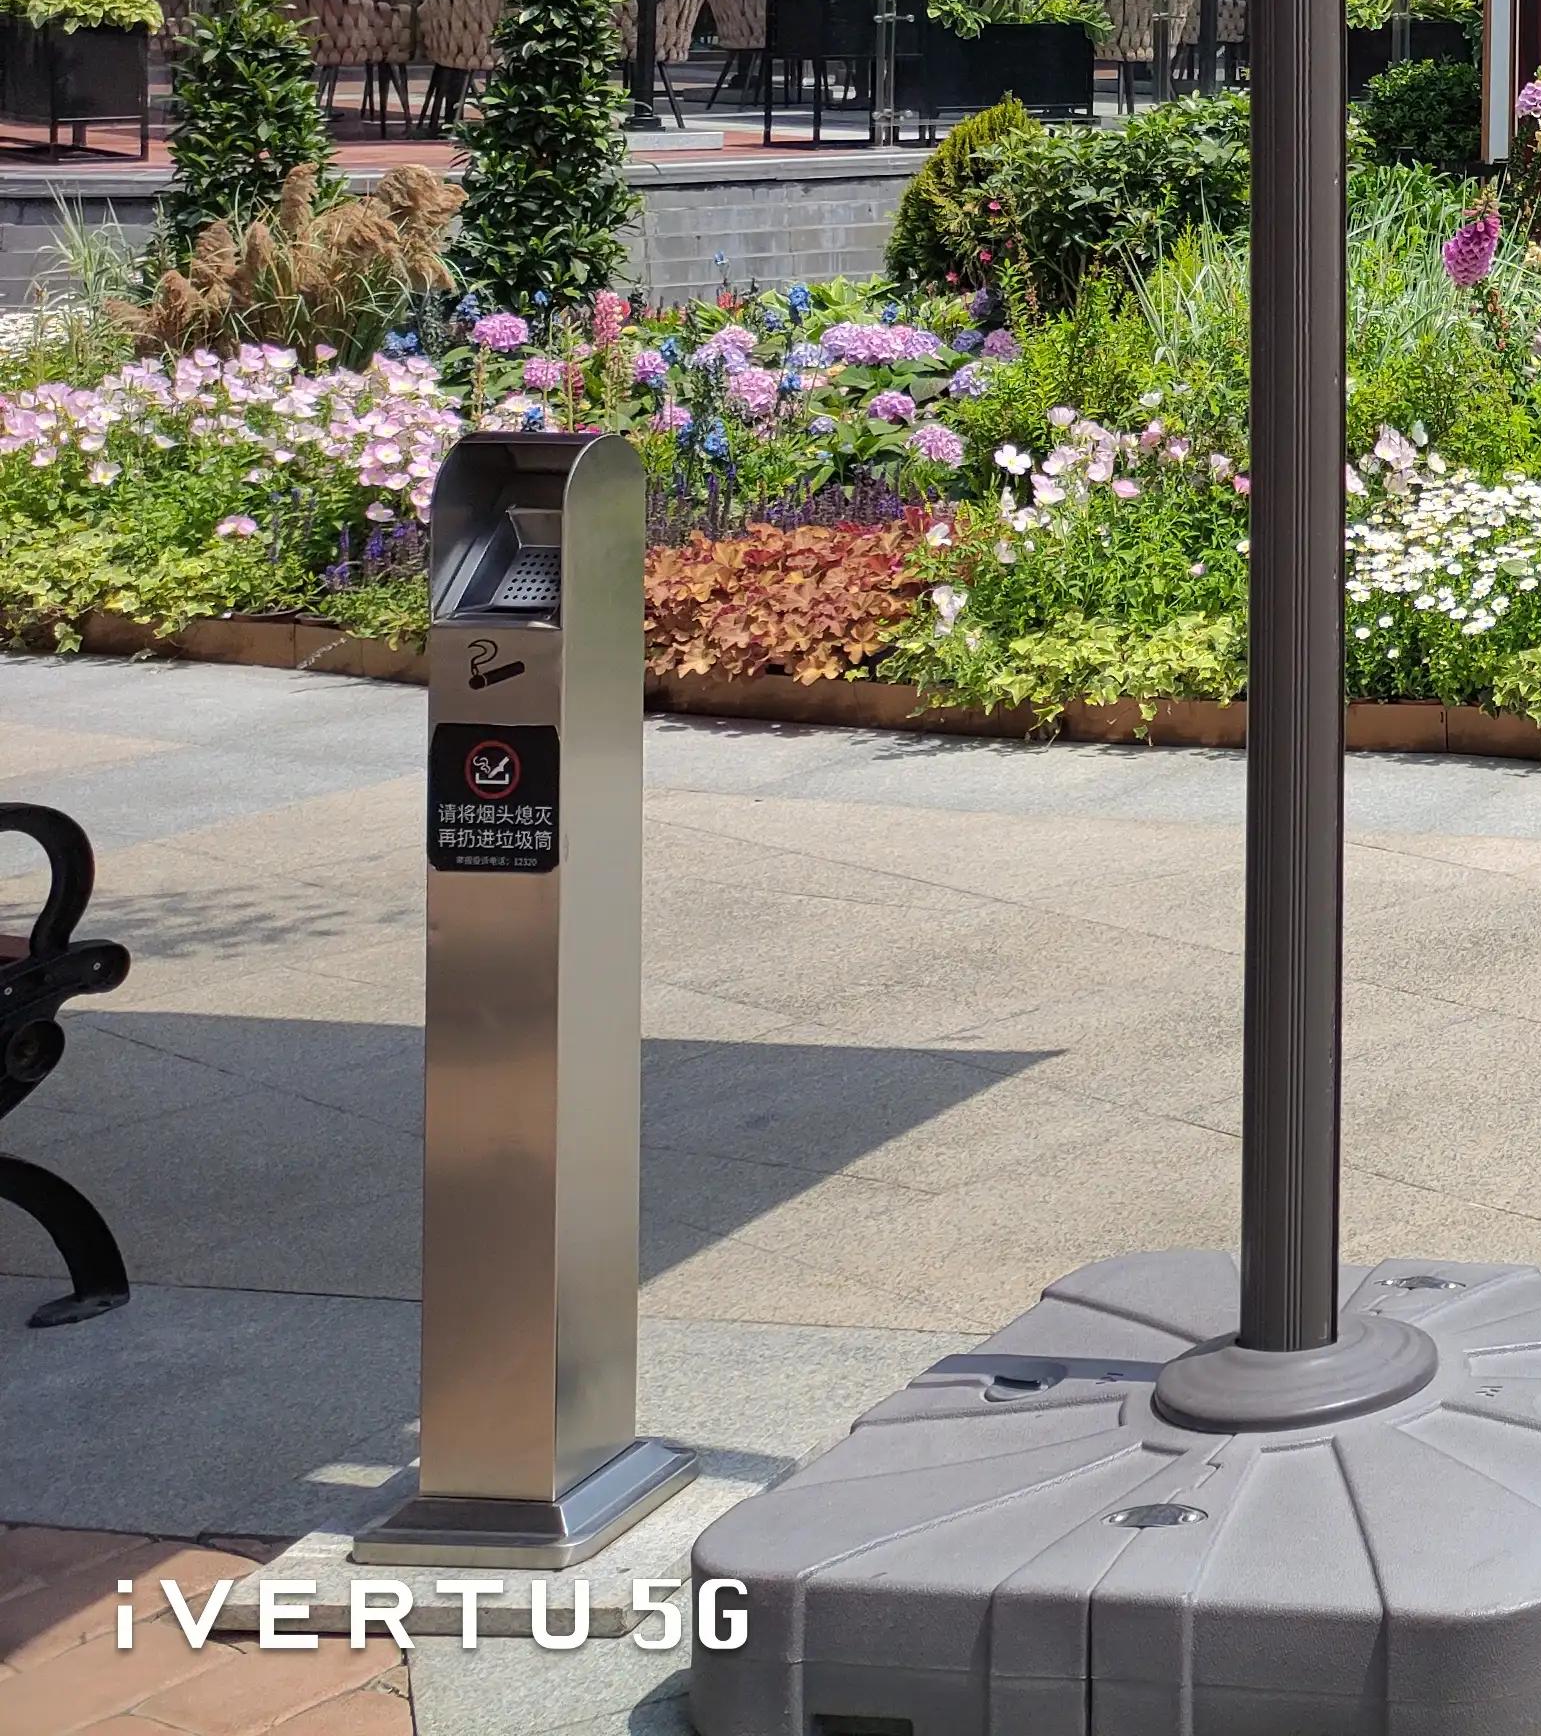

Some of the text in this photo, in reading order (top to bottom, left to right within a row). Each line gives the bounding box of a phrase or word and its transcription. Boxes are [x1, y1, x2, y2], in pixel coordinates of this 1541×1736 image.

[438, 803, 553, 826] 请将烟头熄灭
[438, 828, 553, 851] 再扔进垃圾筒
